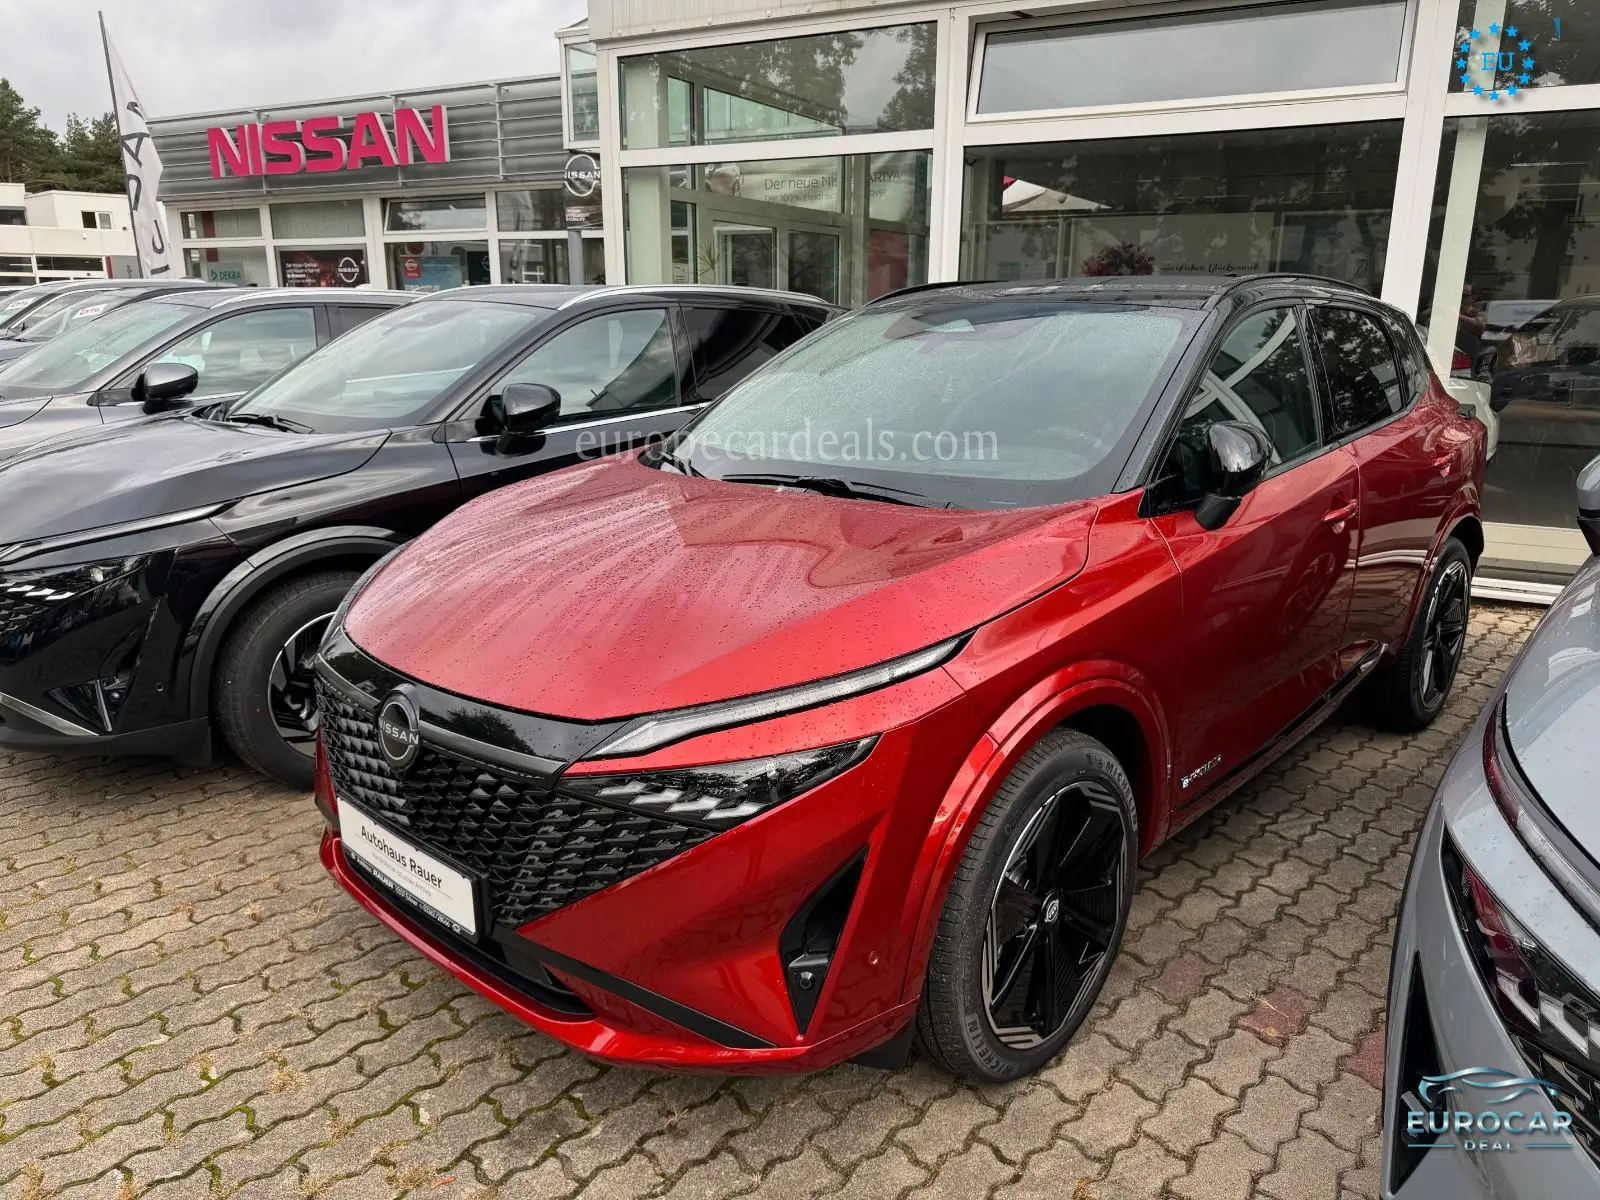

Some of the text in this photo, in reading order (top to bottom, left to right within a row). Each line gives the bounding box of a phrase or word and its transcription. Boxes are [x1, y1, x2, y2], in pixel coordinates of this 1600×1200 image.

[206, 104, 450, 180] NISSAN
[764, 178, 786, 191] Der
[788, 178, 819, 190] neue
[219, 269, 242, 281] DEKRA
[361, 825, 407, 868] Autohaus
[408, 857, 443, 889] Rauer
